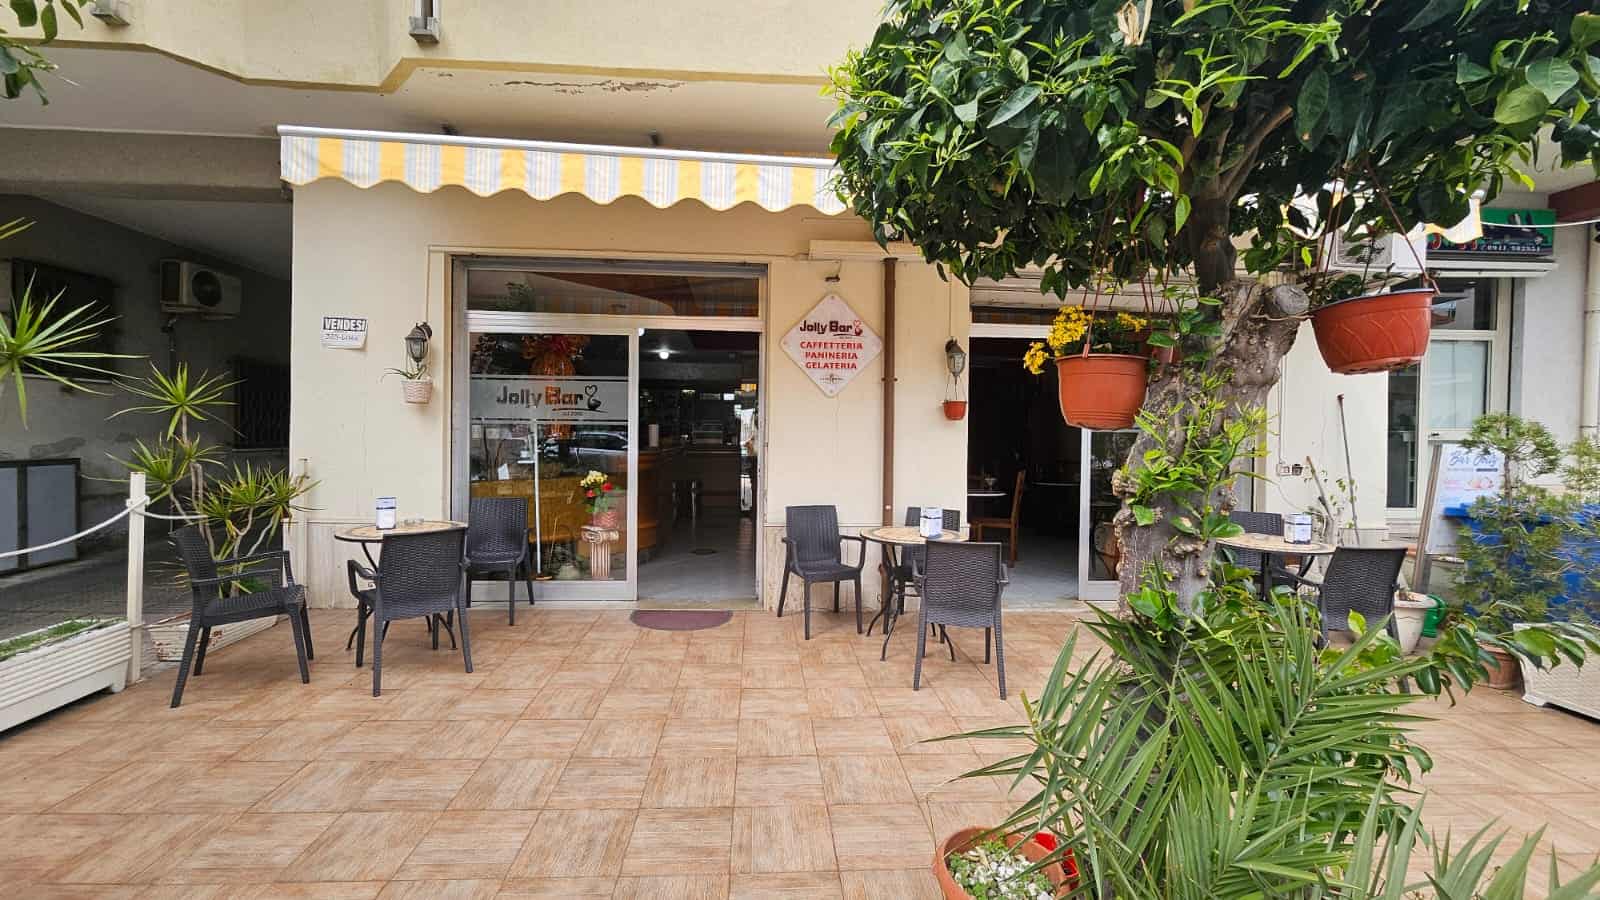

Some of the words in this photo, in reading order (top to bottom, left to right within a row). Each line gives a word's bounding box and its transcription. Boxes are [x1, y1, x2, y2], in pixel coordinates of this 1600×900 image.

[323, 318, 366, 331] VENDESI
[799, 320, 827, 334] Jolly
[829, 320, 853, 332] Bar
[800, 341, 863, 350] CAFFETTERIA
[805, 351, 858, 360] PANINERIA
[805, 361, 857, 370] GELATERIA
[496, 385, 542, 408] Jolly
[545, 385, 584, 406] Bar
